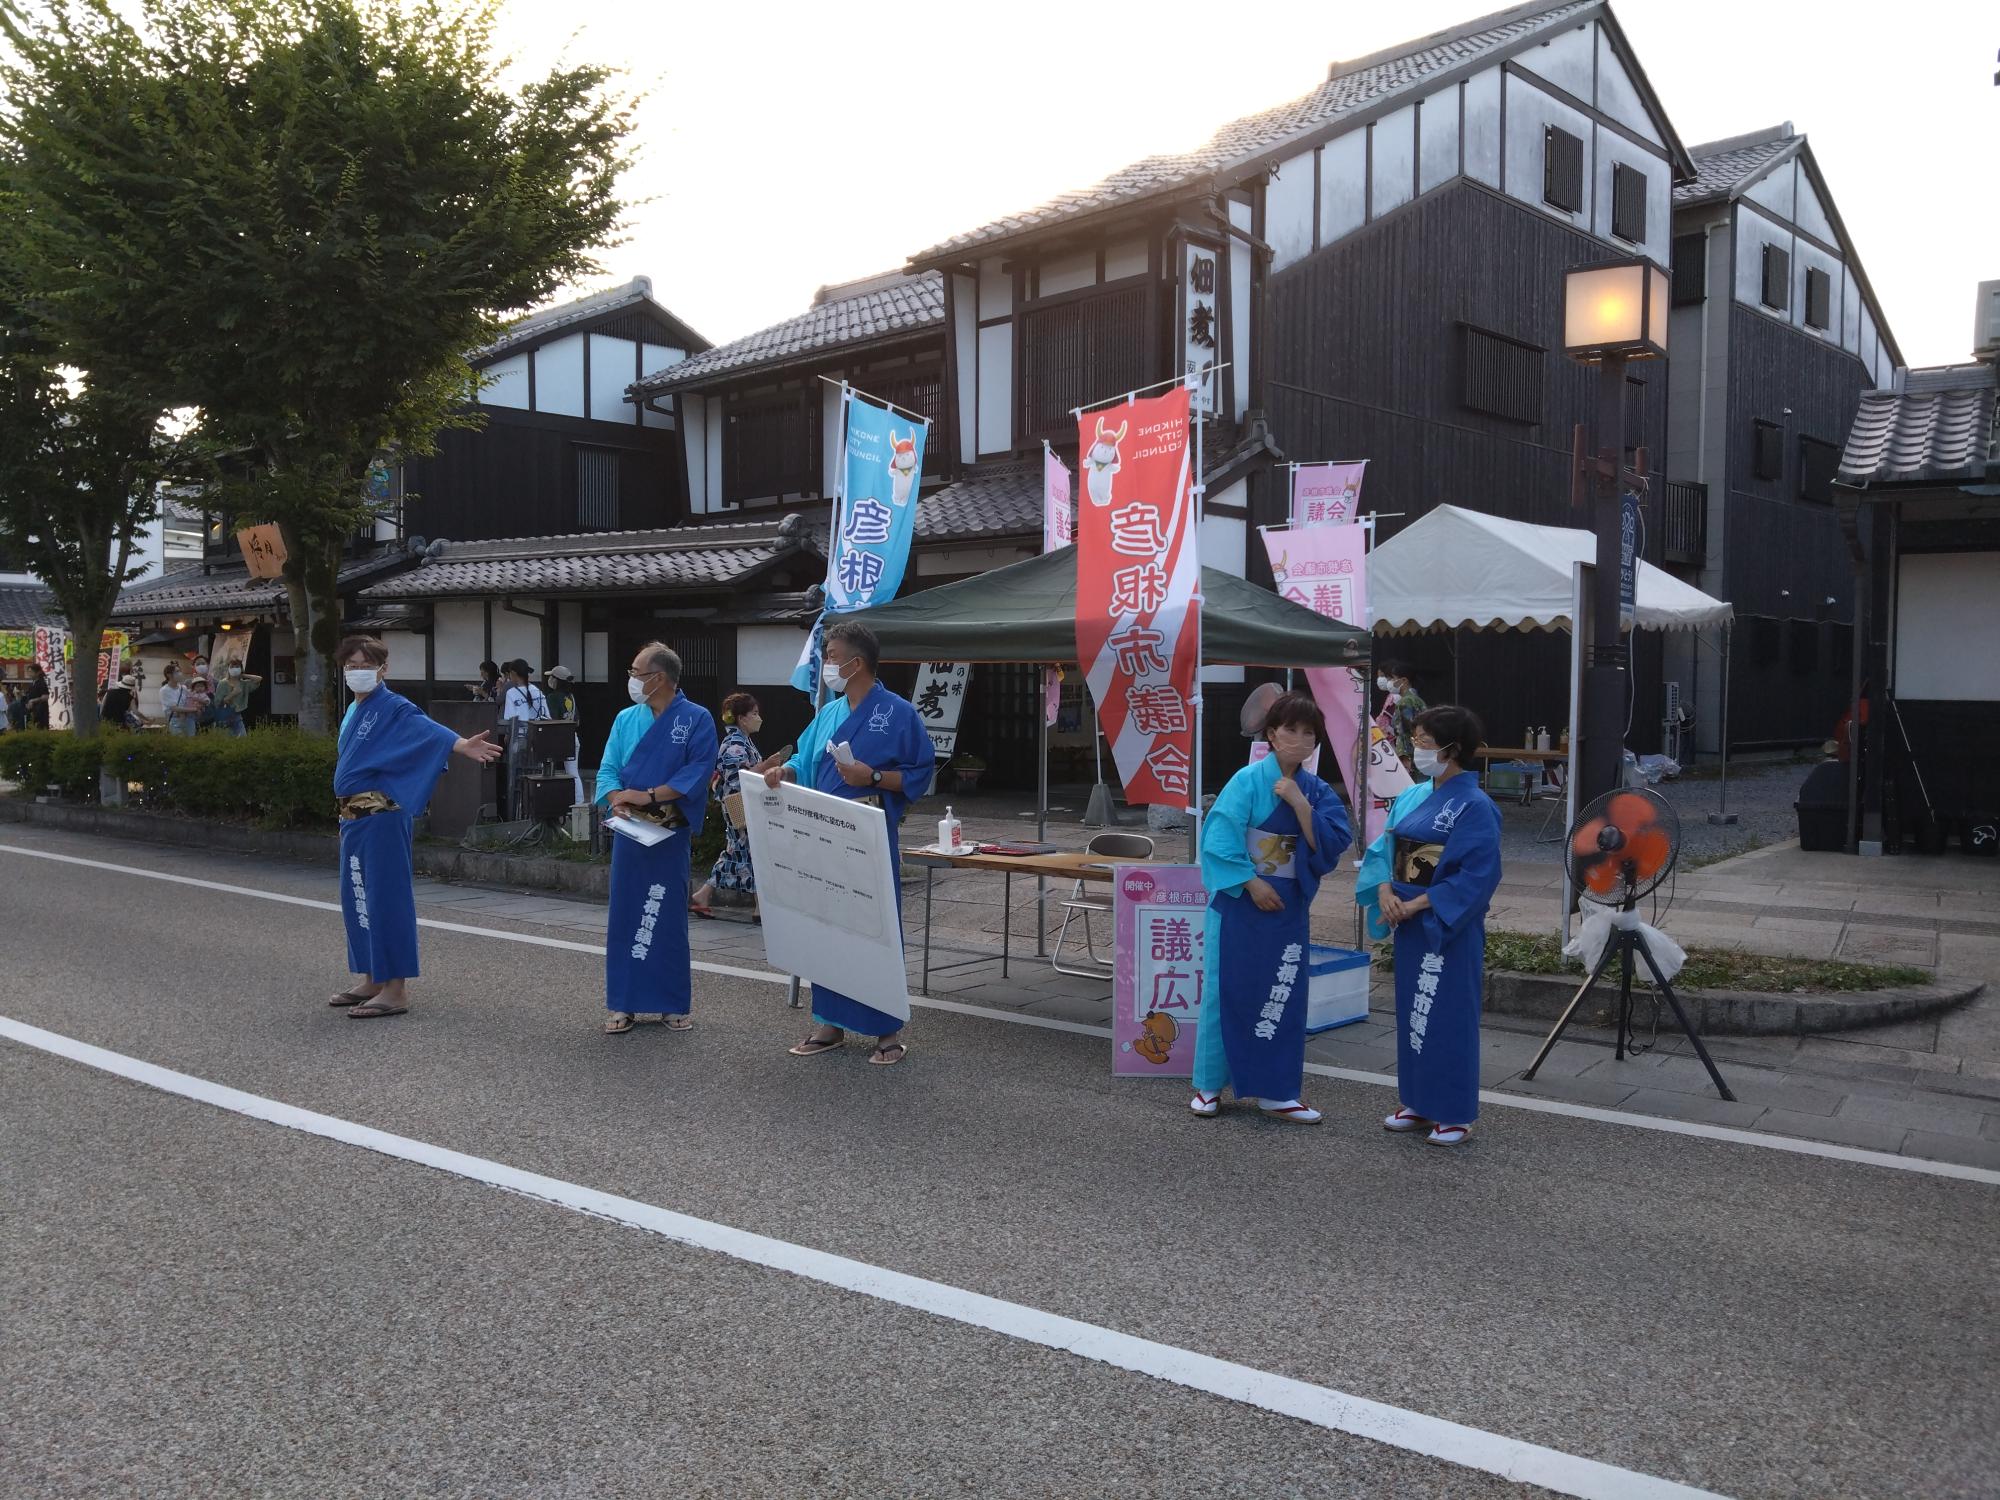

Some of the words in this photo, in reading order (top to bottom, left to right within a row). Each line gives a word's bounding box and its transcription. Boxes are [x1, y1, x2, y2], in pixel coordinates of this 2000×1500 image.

[838, 497, 893, 607] 彦根
[1125, 880, 1153, 892] 開催中
[1150, 917, 1204, 962] 議
[1149, 966, 1204, 1010] 広
[1255, 943, 1303, 1041] 彦根市議会
[1409, 952, 1445, 1055] 彦根市議会
